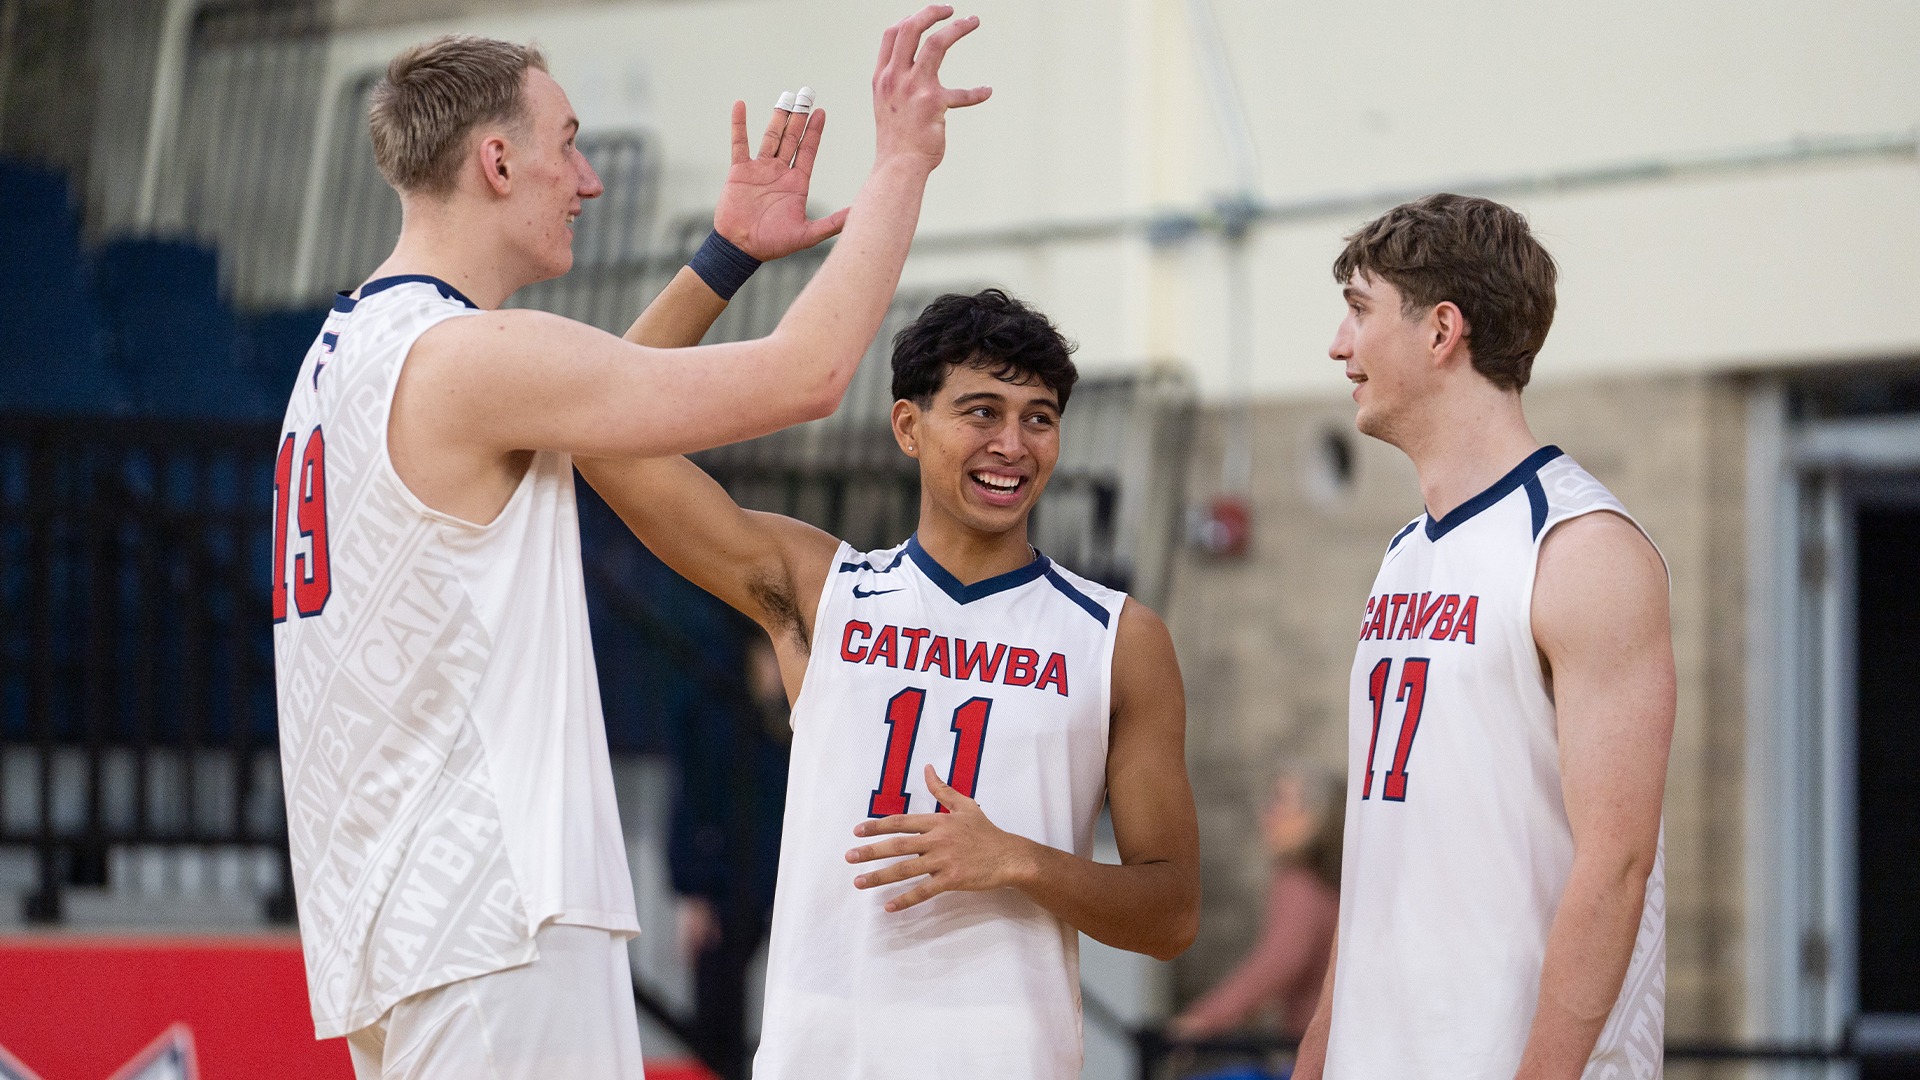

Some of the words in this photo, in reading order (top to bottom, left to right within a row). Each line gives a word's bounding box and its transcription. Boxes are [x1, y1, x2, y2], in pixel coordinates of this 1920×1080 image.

[272, 424, 332, 624] 19
[840, 619, 1068, 697] CATAWBA
[1359, 591, 1479, 645] CATAWBA
[867, 686, 993, 818] 11
[1362, 657, 1430, 802] 17
